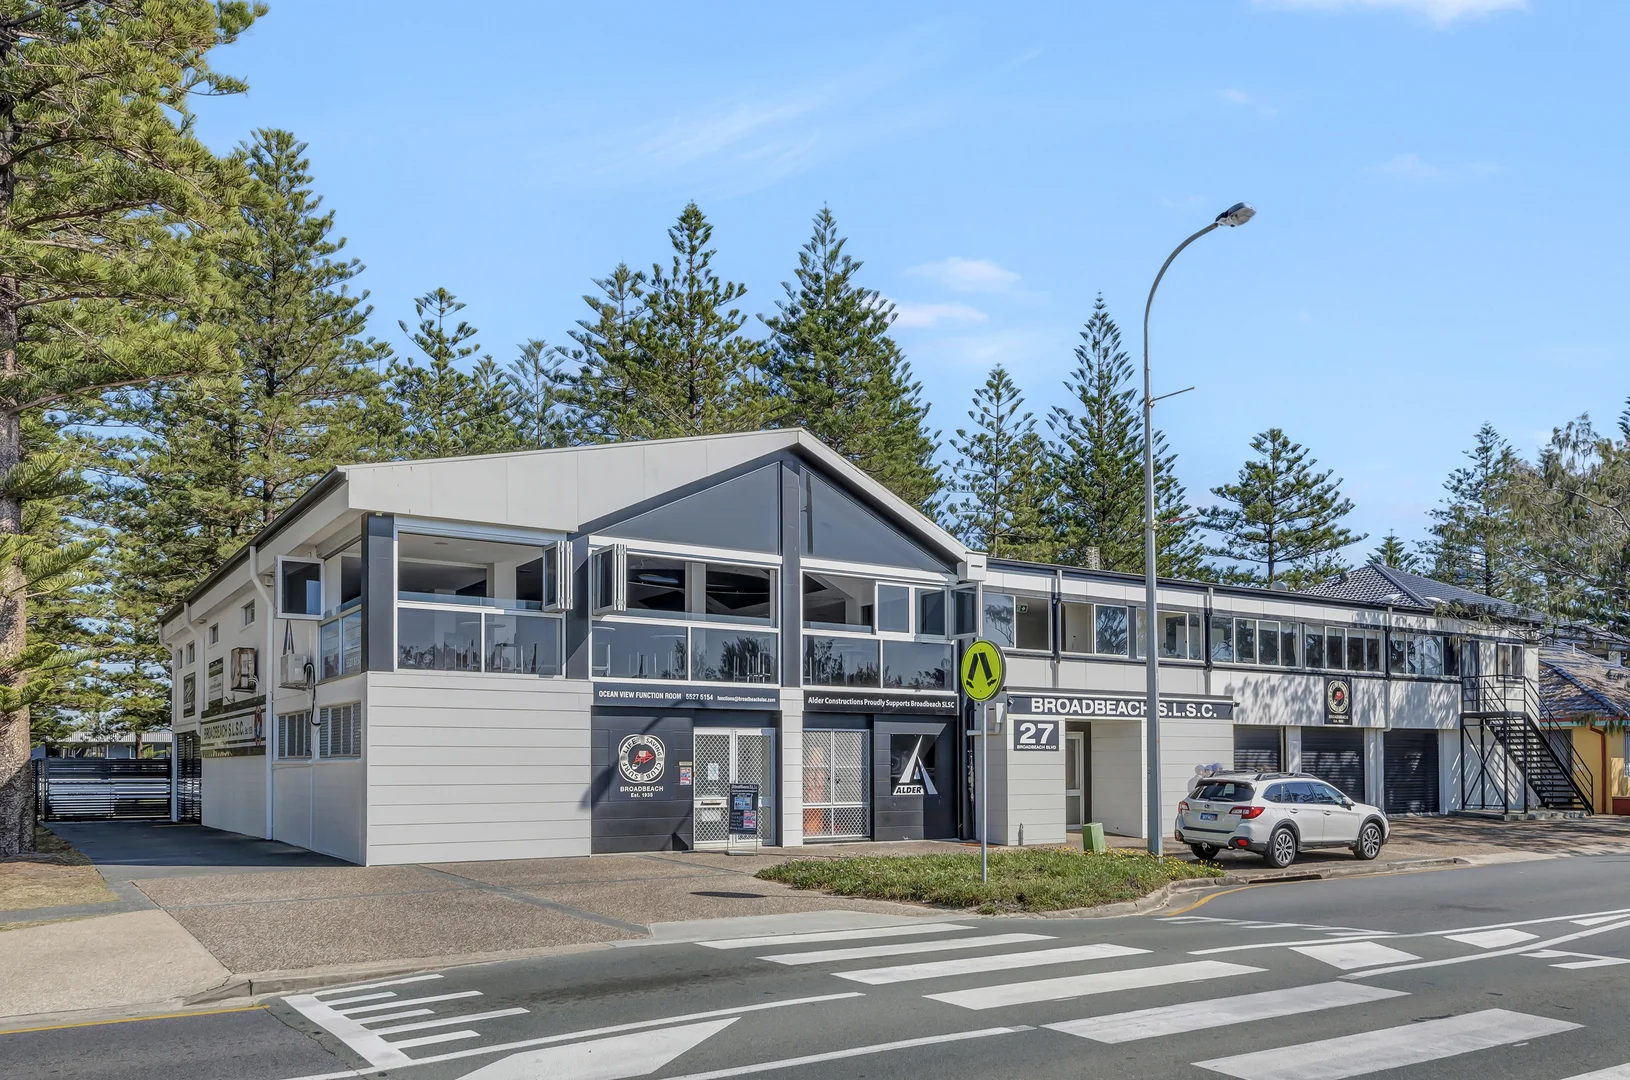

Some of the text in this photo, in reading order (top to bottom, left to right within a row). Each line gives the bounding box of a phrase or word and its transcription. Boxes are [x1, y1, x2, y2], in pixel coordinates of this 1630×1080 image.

[864, 699, 885, 707] Proudly
[1031, 698, 1217, 718] BROADBEACH S.L.S.C.
[1020, 722, 1054, 744] 27
[622, 739, 637, 754] LIFE
[646, 738, 662, 756] SAVING
[622, 761, 639, 780] SURF
[646, 762, 662, 780] CLUB
